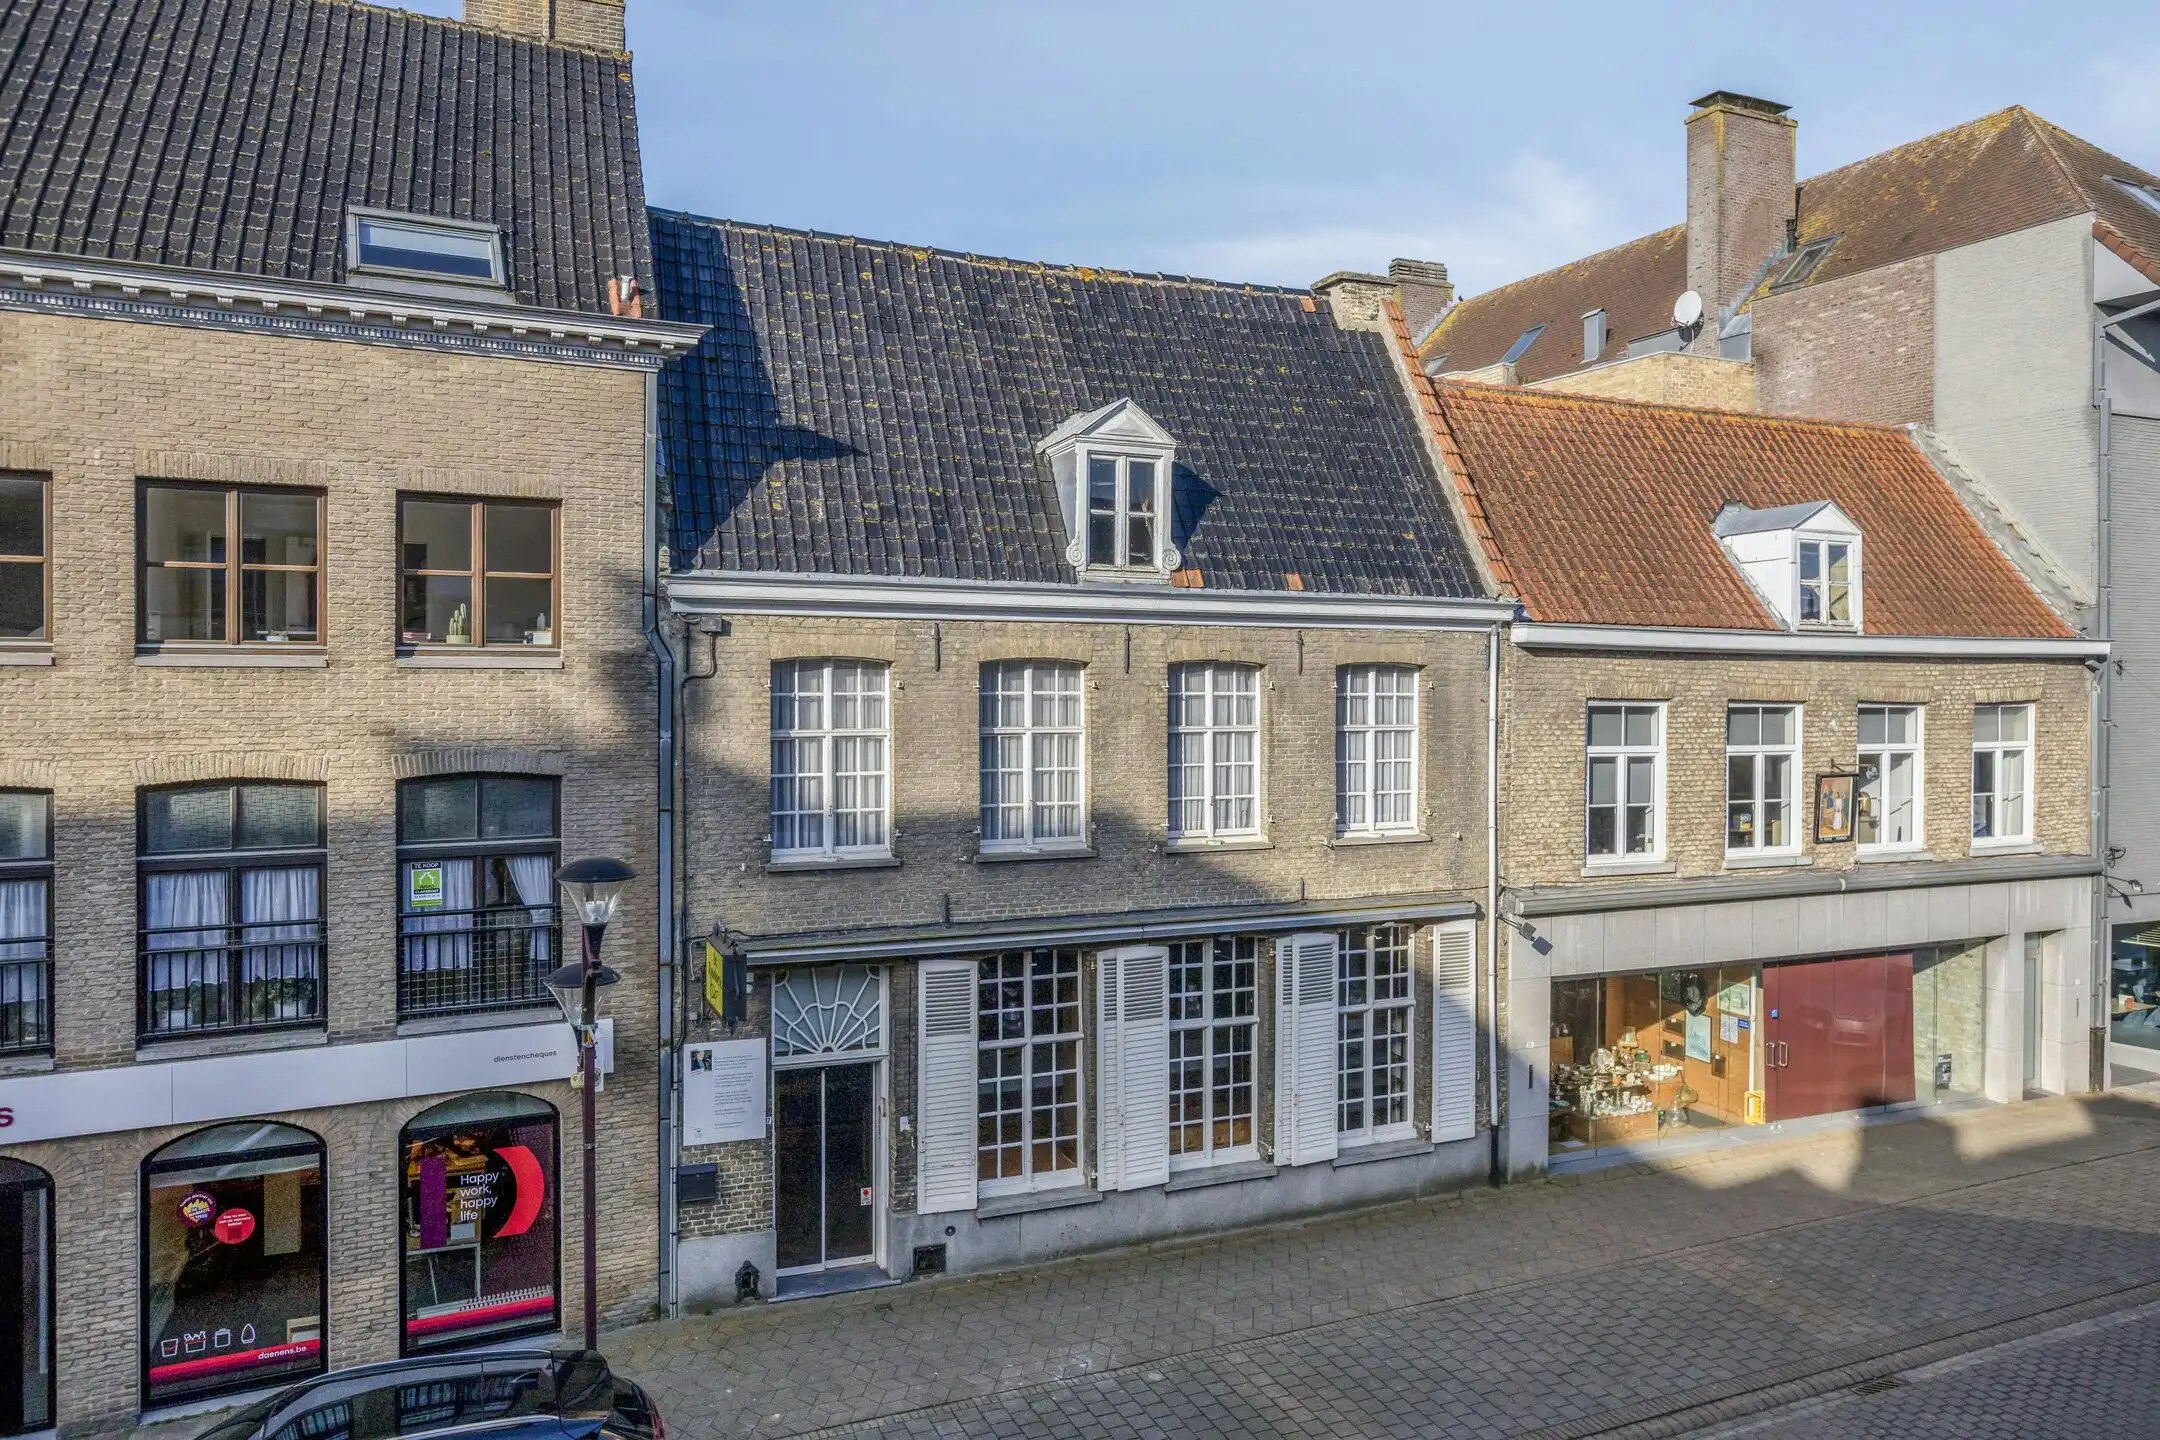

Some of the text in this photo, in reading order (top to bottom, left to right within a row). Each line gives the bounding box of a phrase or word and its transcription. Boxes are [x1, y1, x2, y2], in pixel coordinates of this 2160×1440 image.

[493, 1050, 557, 1063] dienstencheques
[460, 1172, 500, 1185] Happy
[460, 1184, 492, 1197] work,
[460, 1196, 498, 1209] happy
[460, 1209, 478, 1222] life
[258, 1346, 307, 1359] daenens.be
